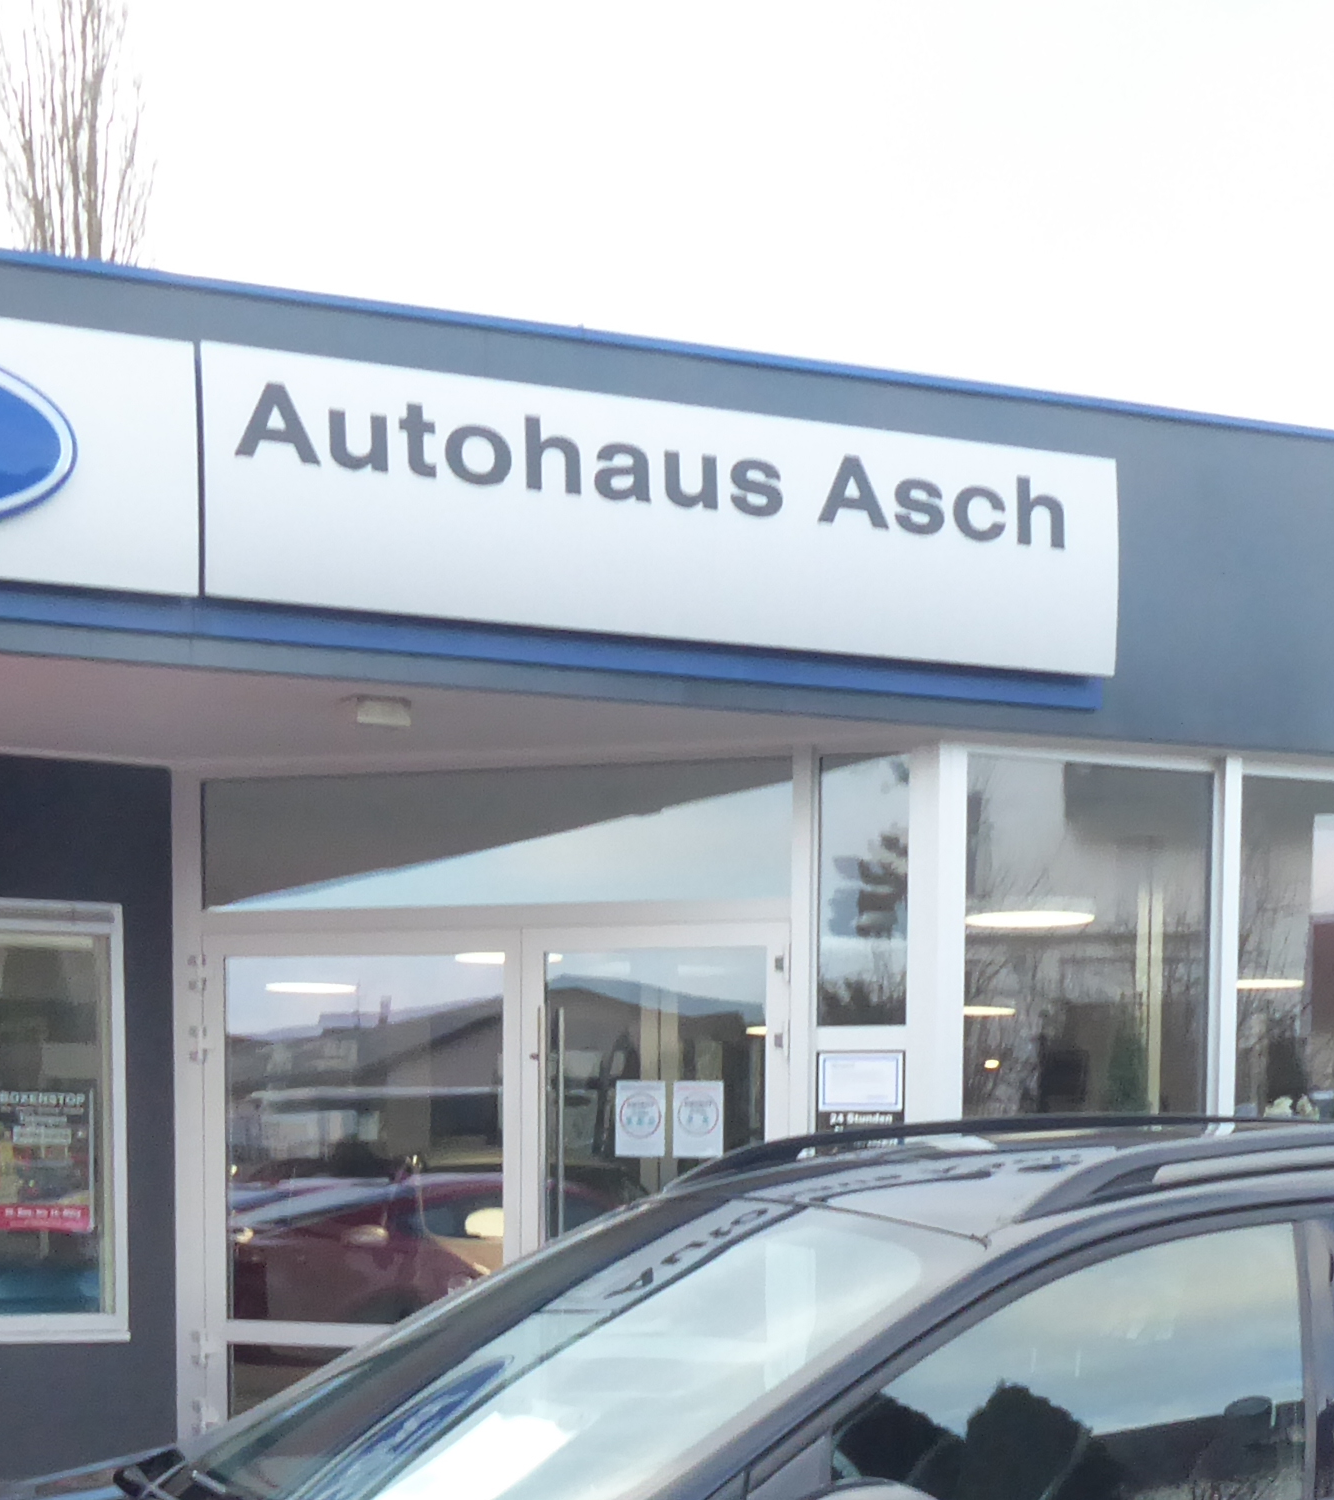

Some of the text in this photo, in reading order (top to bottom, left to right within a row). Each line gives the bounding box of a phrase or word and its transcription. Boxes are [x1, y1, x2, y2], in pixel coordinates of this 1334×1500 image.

[234, 381, 1066, 551] Autohaus Asch
[0, 1090, 85, 1106] BOXENSTOP
[829, 1112, 893, 1125] 24 Stunden
